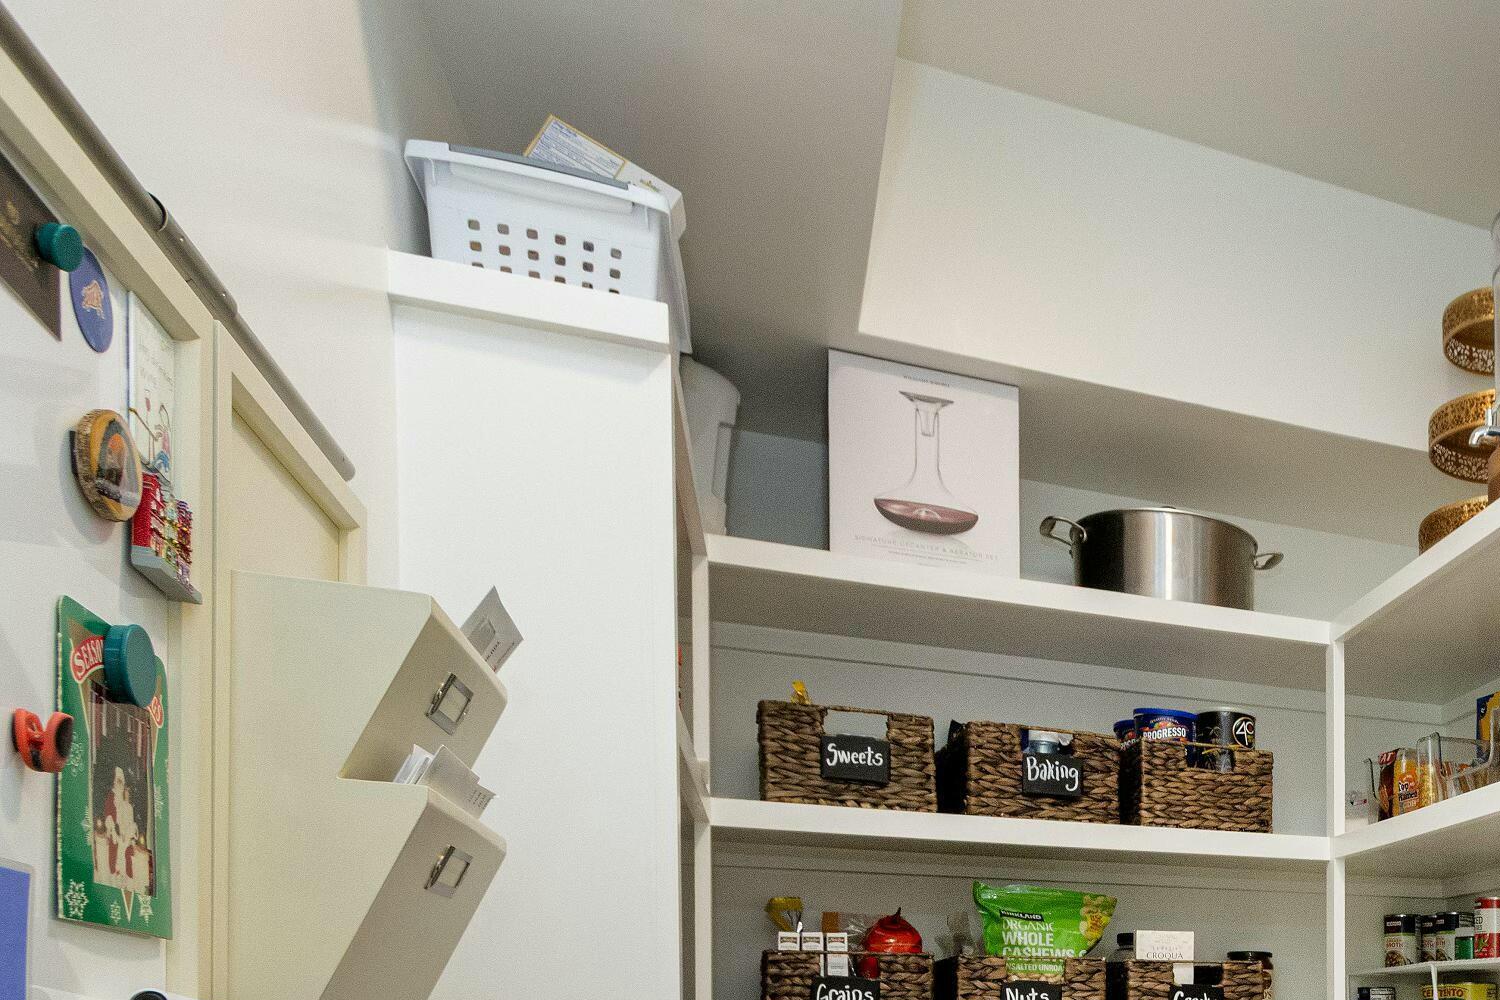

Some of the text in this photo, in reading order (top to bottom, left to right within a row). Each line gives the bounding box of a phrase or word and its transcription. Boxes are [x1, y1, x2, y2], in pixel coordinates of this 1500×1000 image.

[1142, 727, 1187, 742] PROGRESSO
[825, 742, 884, 767] Sweets
[1026, 756, 1079, 792] Baking
[1002, 930, 1054, 948] WHOLE
